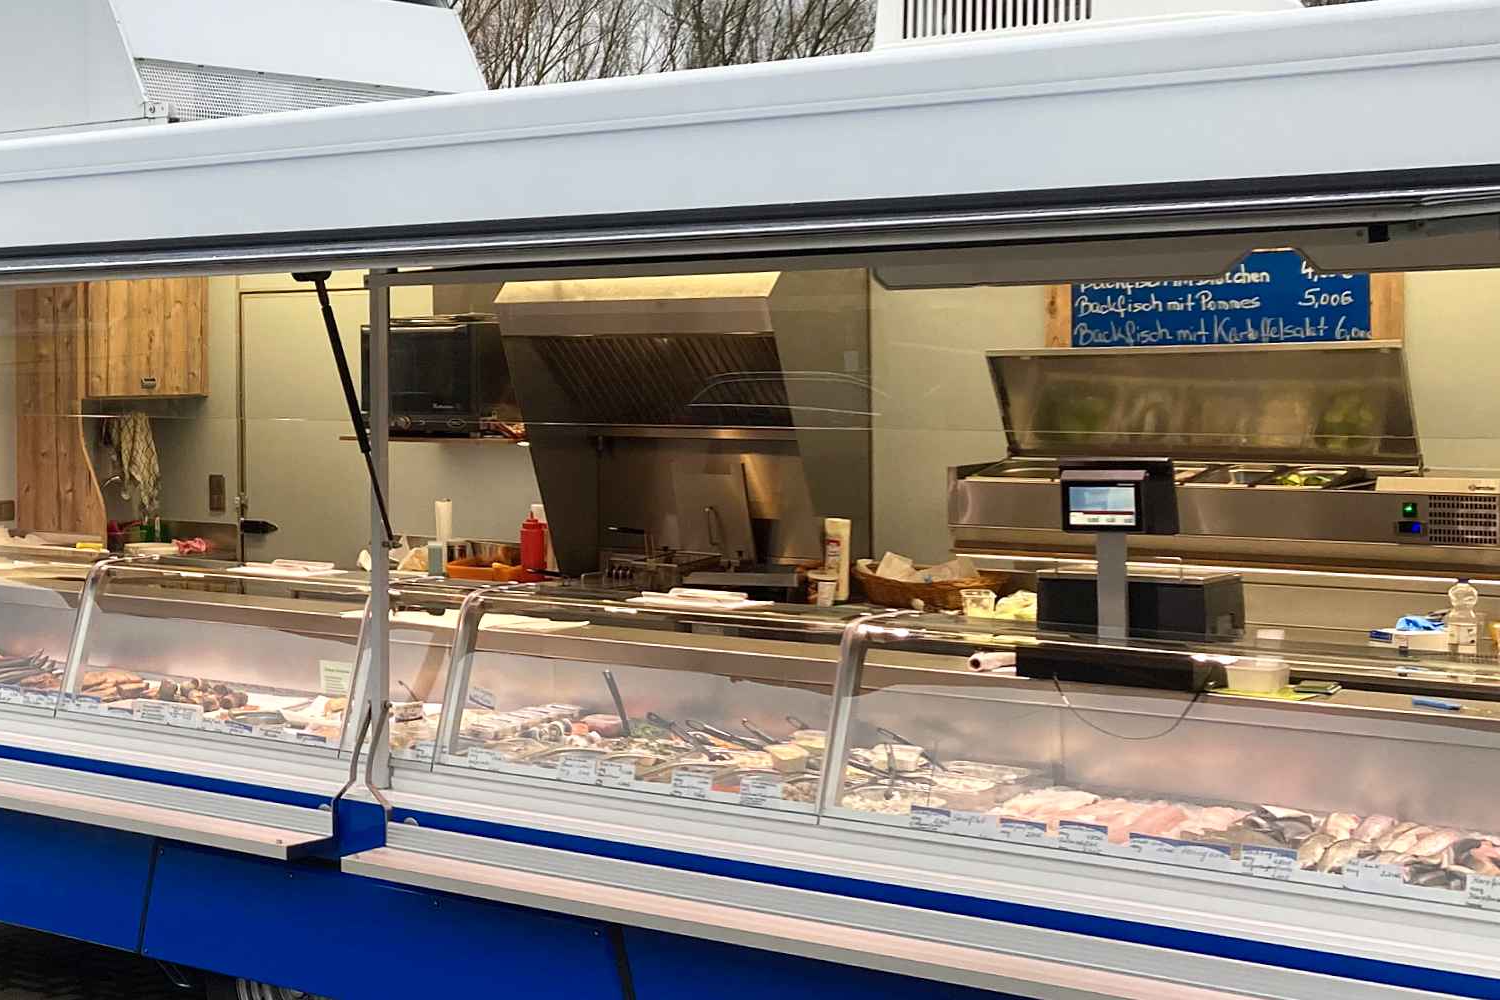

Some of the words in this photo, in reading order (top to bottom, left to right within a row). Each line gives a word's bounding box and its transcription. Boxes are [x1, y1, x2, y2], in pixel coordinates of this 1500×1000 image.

[1075, 295, 1163, 318] Backfisch
[1166, 293, 1195, 311] mit
[1195, 290, 1261, 311] Pommes
[1074, 320, 1173, 346] Backfisch
[1176, 317, 1209, 343] mit
